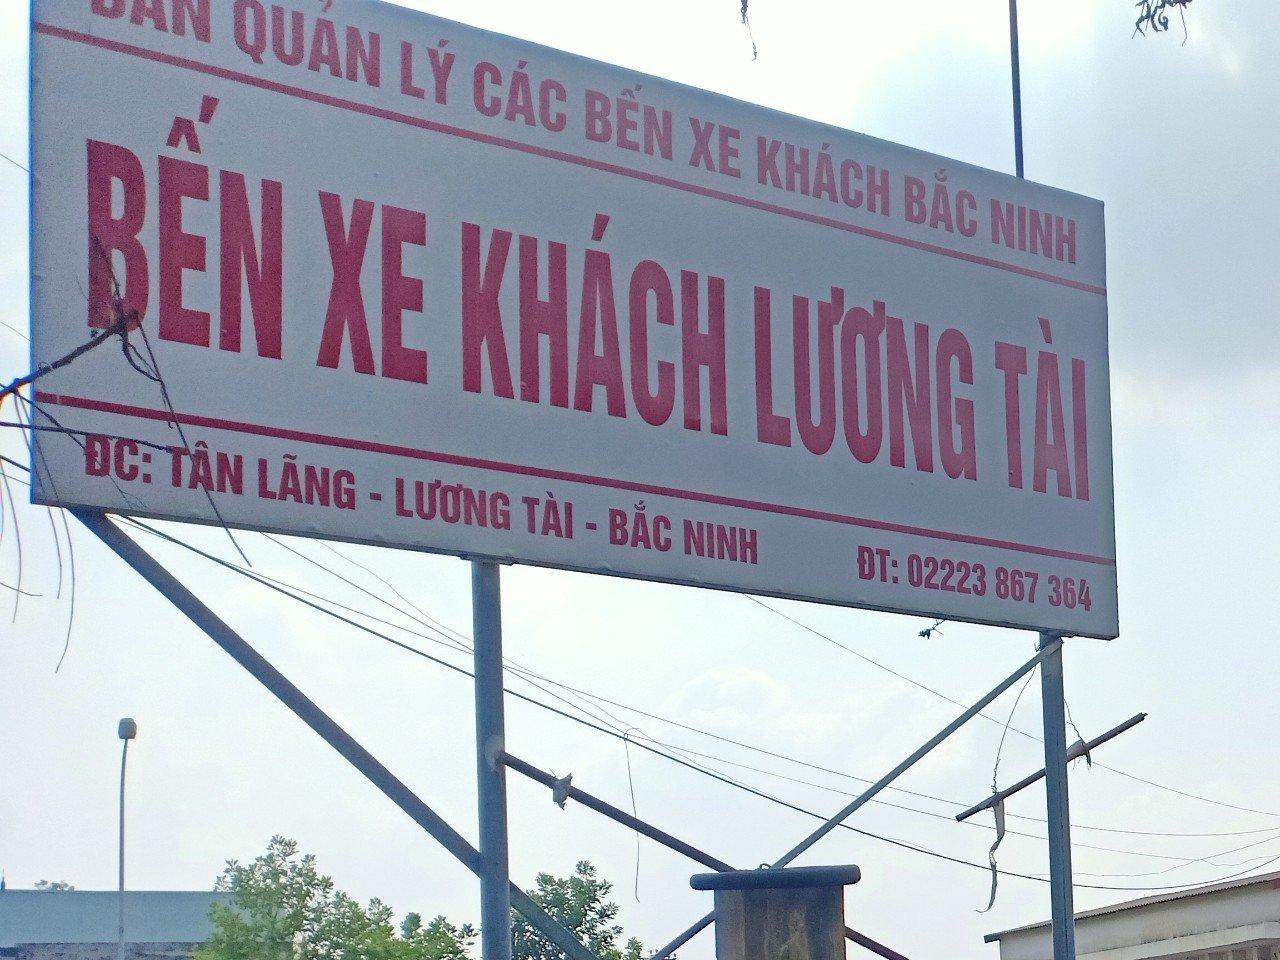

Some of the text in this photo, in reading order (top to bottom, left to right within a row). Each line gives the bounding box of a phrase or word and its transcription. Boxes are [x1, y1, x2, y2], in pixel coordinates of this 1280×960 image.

[233, 0, 381, 87] QUẢN
[400, 39, 456, 105] LÝ
[473, 60, 568, 132] CÁC
[584, 84, 673, 161] BẾN
[688, 117, 742, 179] XE
[757, 143, 890, 217] KHÁCH
[904, 168, 978, 238] BẮC
[990, 198, 1077, 264] NINH
[87, 96, 1090, 501] BẾN XE KHÁCH LƯƠNG TÀI
[84, 434, 151, 483] ĐC:
[166, 440, 243, 495] TÂN
[257, 453, 356, 510] LÃNG
[395, 477, 511, 531] LƯƠNG
[522, 490, 573, 539] TÀI
[609, 500, 672, 552] BẮC
[683, 518, 758, 565] NINH
[857, 545, 1092, 612] ĐT: 02223 867 364
